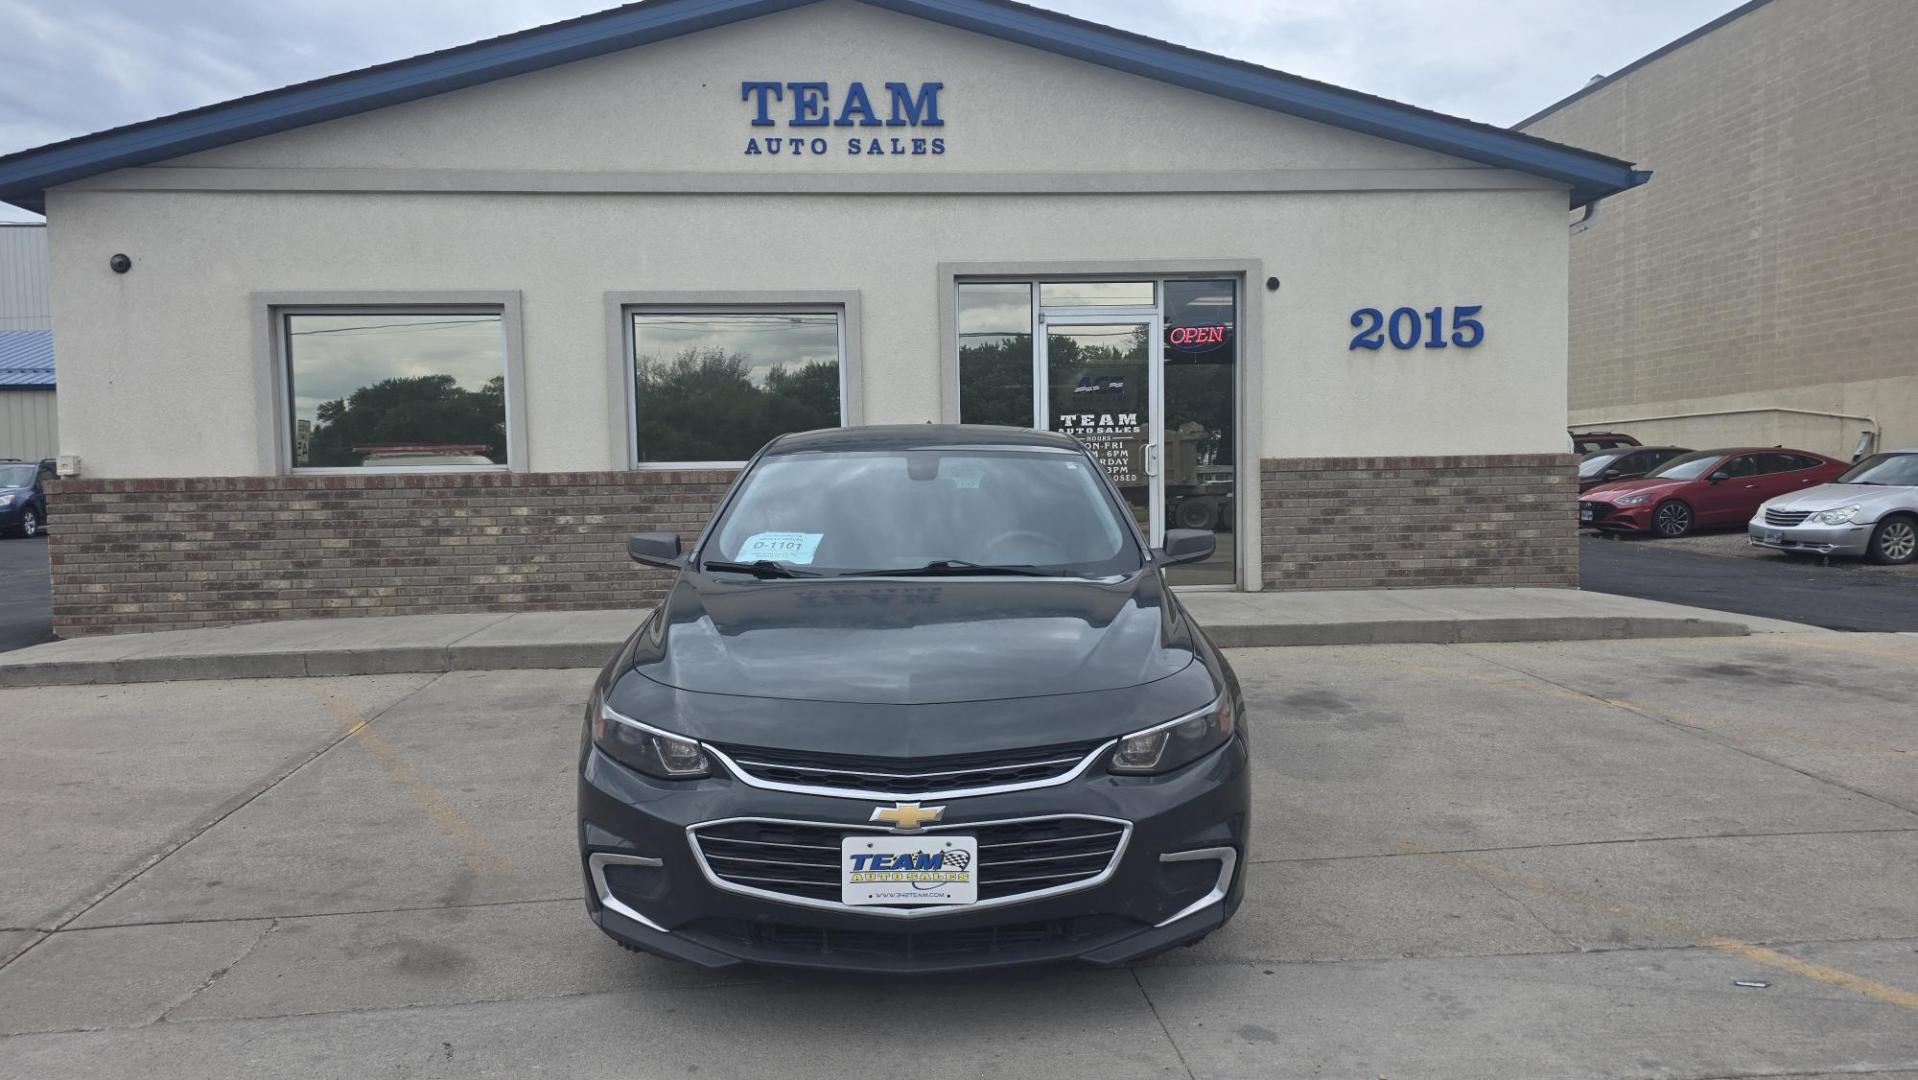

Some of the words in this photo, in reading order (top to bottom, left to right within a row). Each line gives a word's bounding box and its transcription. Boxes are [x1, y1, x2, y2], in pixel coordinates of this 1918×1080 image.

[742, 81, 945, 127] TEAM
[744, 138, 828, 155] AUTO
[848, 138, 946, 155] SALES
[1349, 305, 1485, 350] 2015
[1170, 326, 1224, 344] OPEN
[1060, 413, 1137, 427] TEAM
[1096, 426, 1140, 434] SALES
[1084, 441, 1123, 450] ON-FRI
[1106, 449, 1129, 458] 6PM
[1106, 466, 1128, 474] 3PM
[1113, 474, 1137, 482] OSED
[753, 541, 802, 551] D-1101
[850, 853, 945, 871] TEAM
[851, 872, 904, 881] AUTO
[906, 872, 970, 881] SALES
